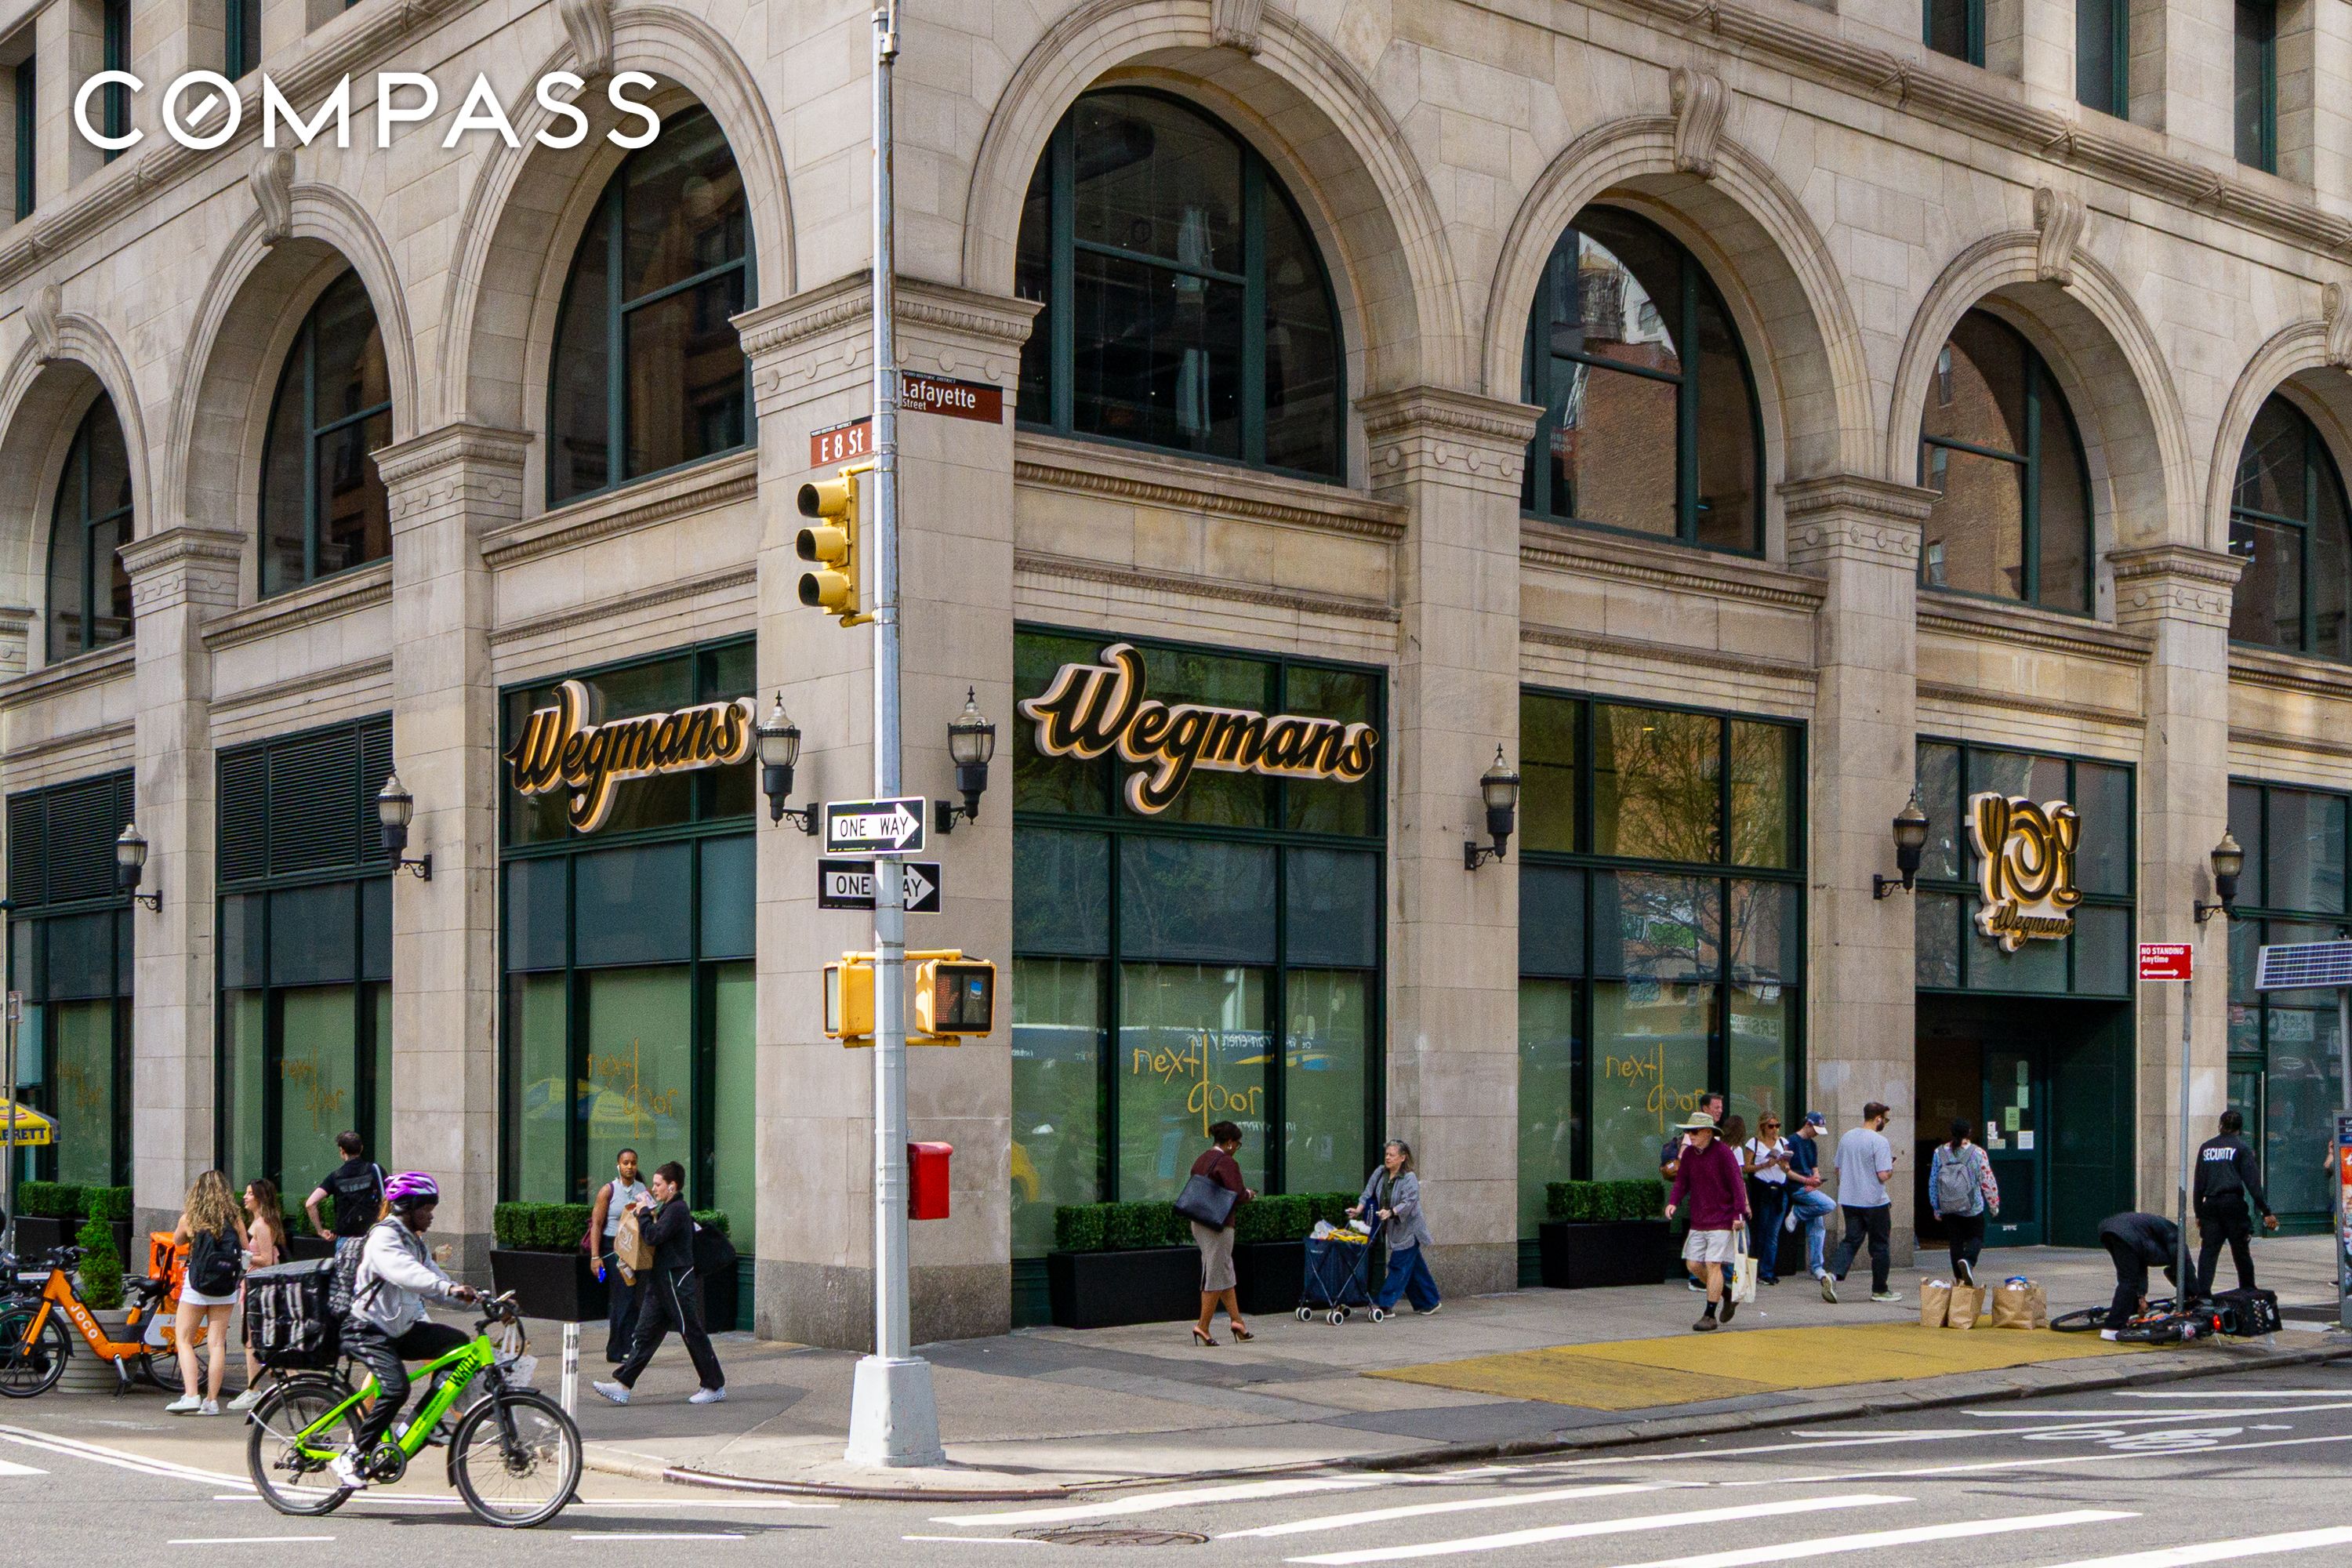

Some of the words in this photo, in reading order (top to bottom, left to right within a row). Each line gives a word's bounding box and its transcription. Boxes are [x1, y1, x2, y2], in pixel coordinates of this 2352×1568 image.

[902, 379, 976, 408] Lafayette
[902, 397, 927, 410] Street
[822, 437, 829, 462] E
[834, 434, 843, 459] 8
[848, 427, 863, 455] St
[1019, 643, 1378, 815] Wegmans
[503, 680, 757, 833] Wegmans
[840, 818, 866, 837] ONE
[880, 816, 908, 836] WAY
[836, 875, 871, 895] ONE
[903, 878, 922, 897] AY
[1985, 898, 2074, 949] Wegmans
[2141, 956, 2169, 964] Anytime
[1133, 1038, 1200, 1084] next
[1606, 1046, 1657, 1087] next
[1188, 1033, 1263, 1138] door
[2203, 1147, 2236, 1161] SECURITY
[71, 1304, 98, 1340] JOCO
[448, 1353, 481, 1387] WHIZZ
